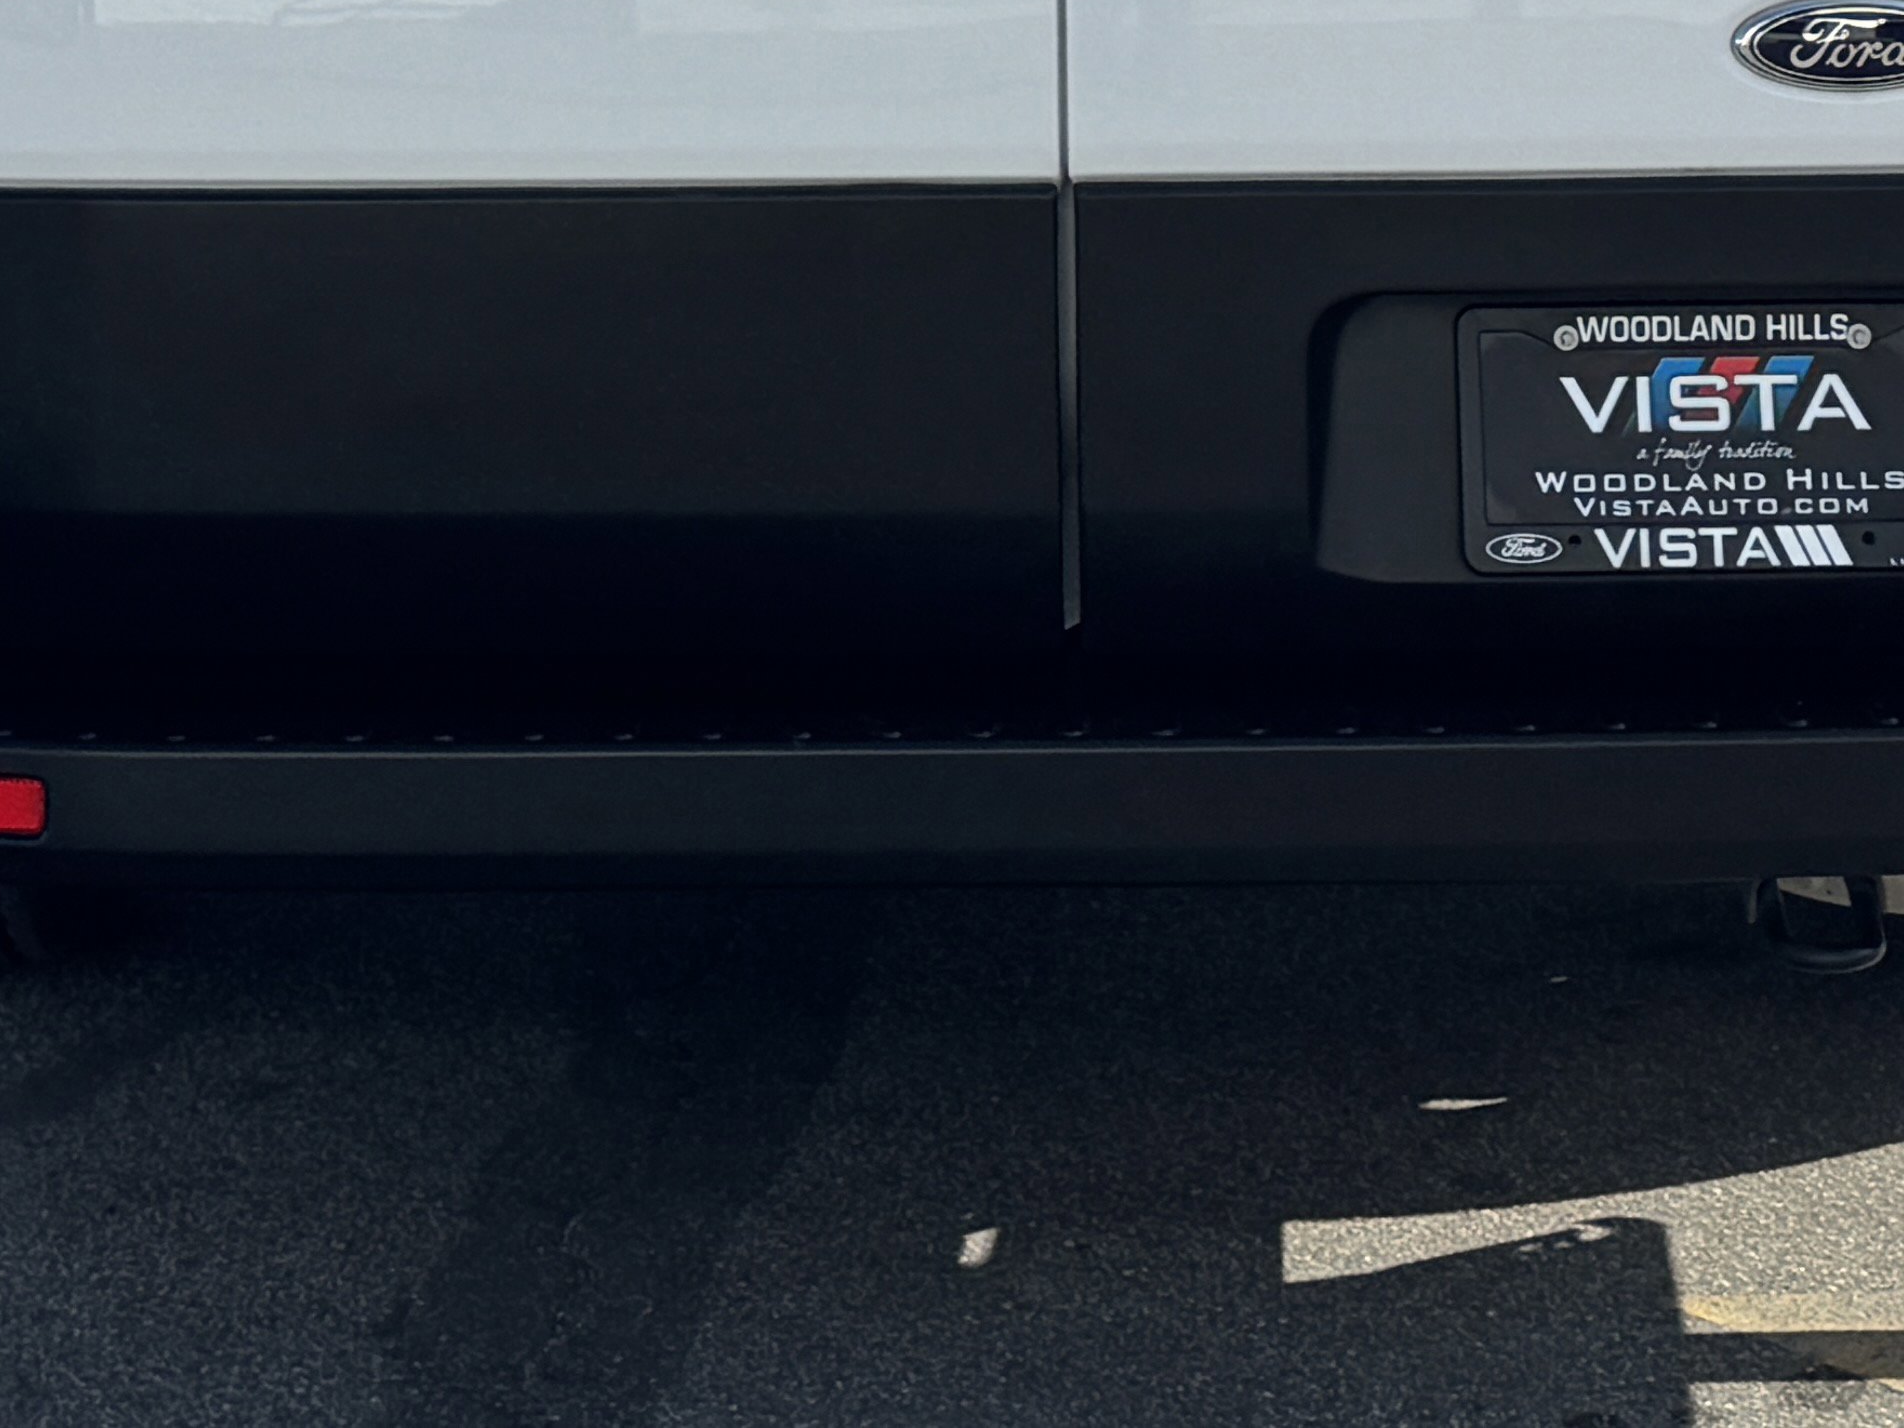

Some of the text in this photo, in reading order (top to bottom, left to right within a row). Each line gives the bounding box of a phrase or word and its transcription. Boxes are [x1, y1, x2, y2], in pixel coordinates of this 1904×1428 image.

[1577, 314, 1849, 343] WOODLAND HILLS
[1560, 372, 1871, 432] VISTA
[1636, 448, 1649, 460] a
[1652, 437, 1713, 471] family
[1500, 538, 1547, 558] Ford
[1594, 527, 1778, 568] VISTA
